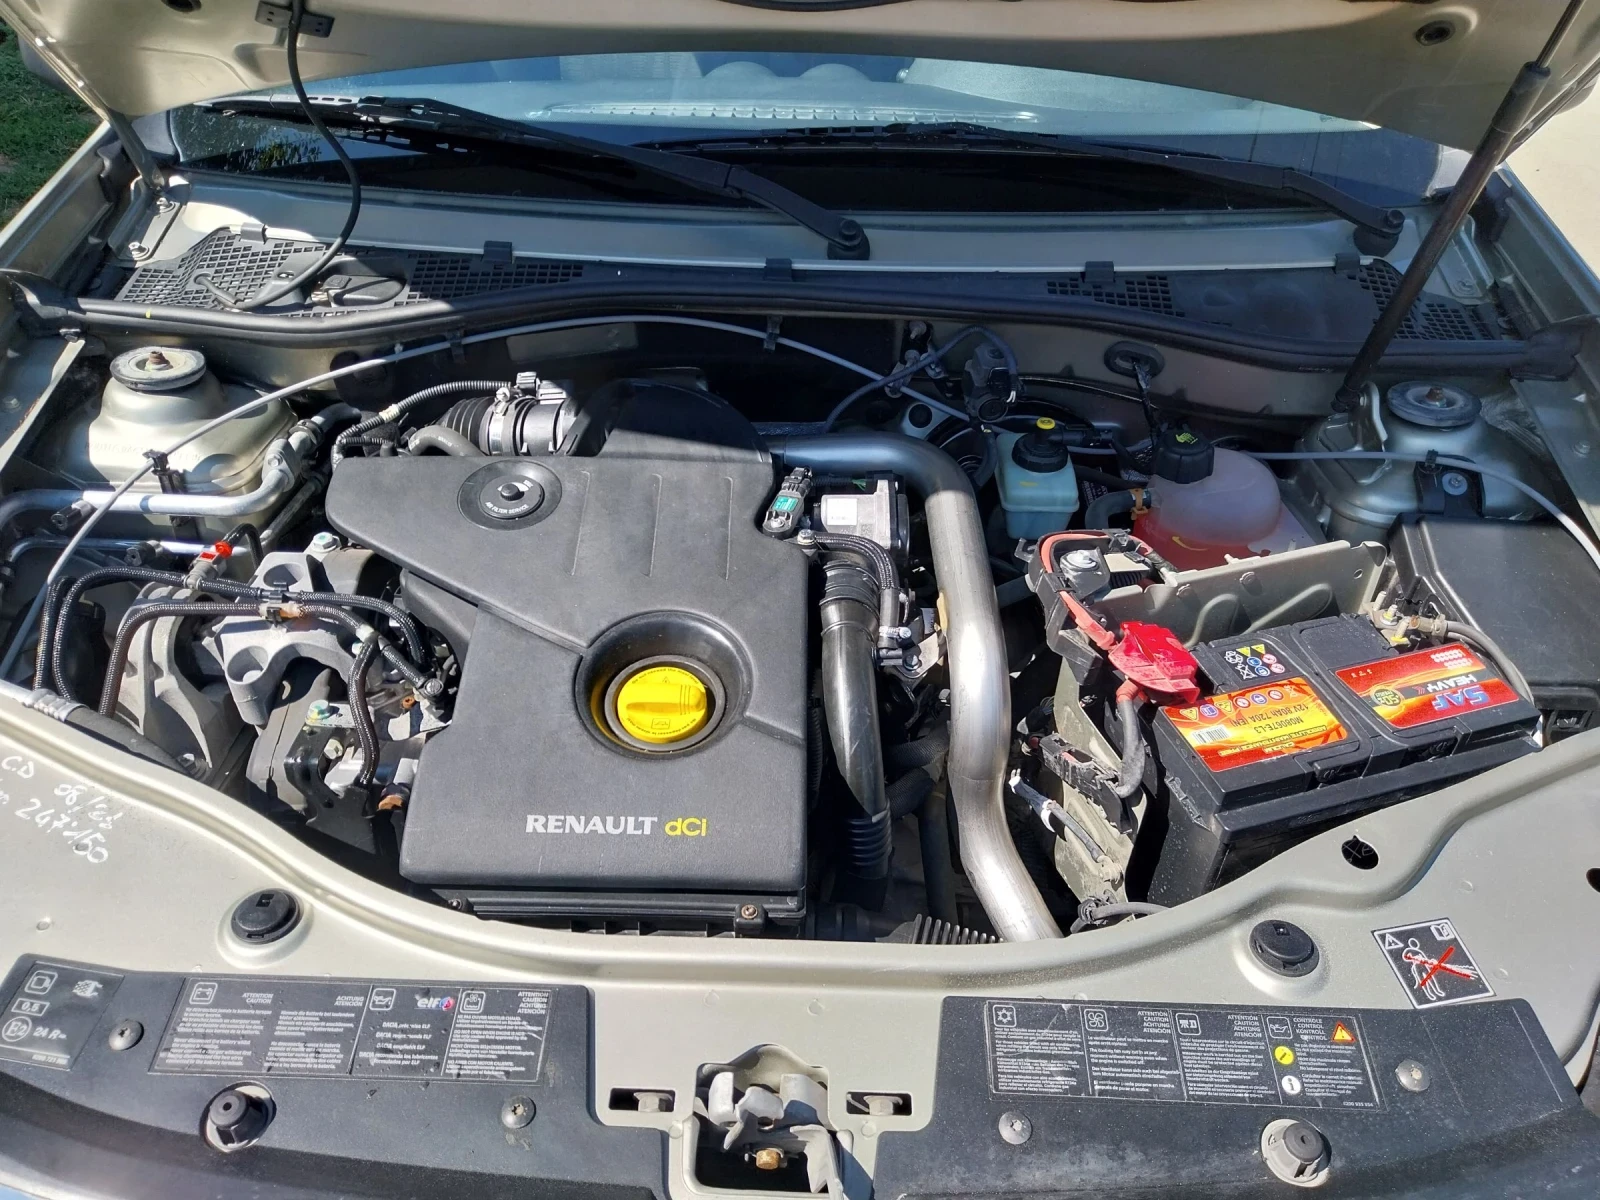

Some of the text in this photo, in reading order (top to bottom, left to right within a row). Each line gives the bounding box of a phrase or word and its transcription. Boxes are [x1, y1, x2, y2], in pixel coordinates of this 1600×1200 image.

[509, 504, 529, 514] SERVICE
[1427, 674, 1478, 693] HEAVY
[1432, 685, 1490, 711] SAF
[1271, 708, 1292, 719] 80Ah
[1294, 704, 1308, 713] 12V
[1250, 712, 1270, 723] 720A
[526, 815, 707, 836] RENAULT dCi
[22, 1002, 40, 1012] 0,5
[6, 1021, 27, 1036] E2
[33, 1026, 49, 1038] 24
